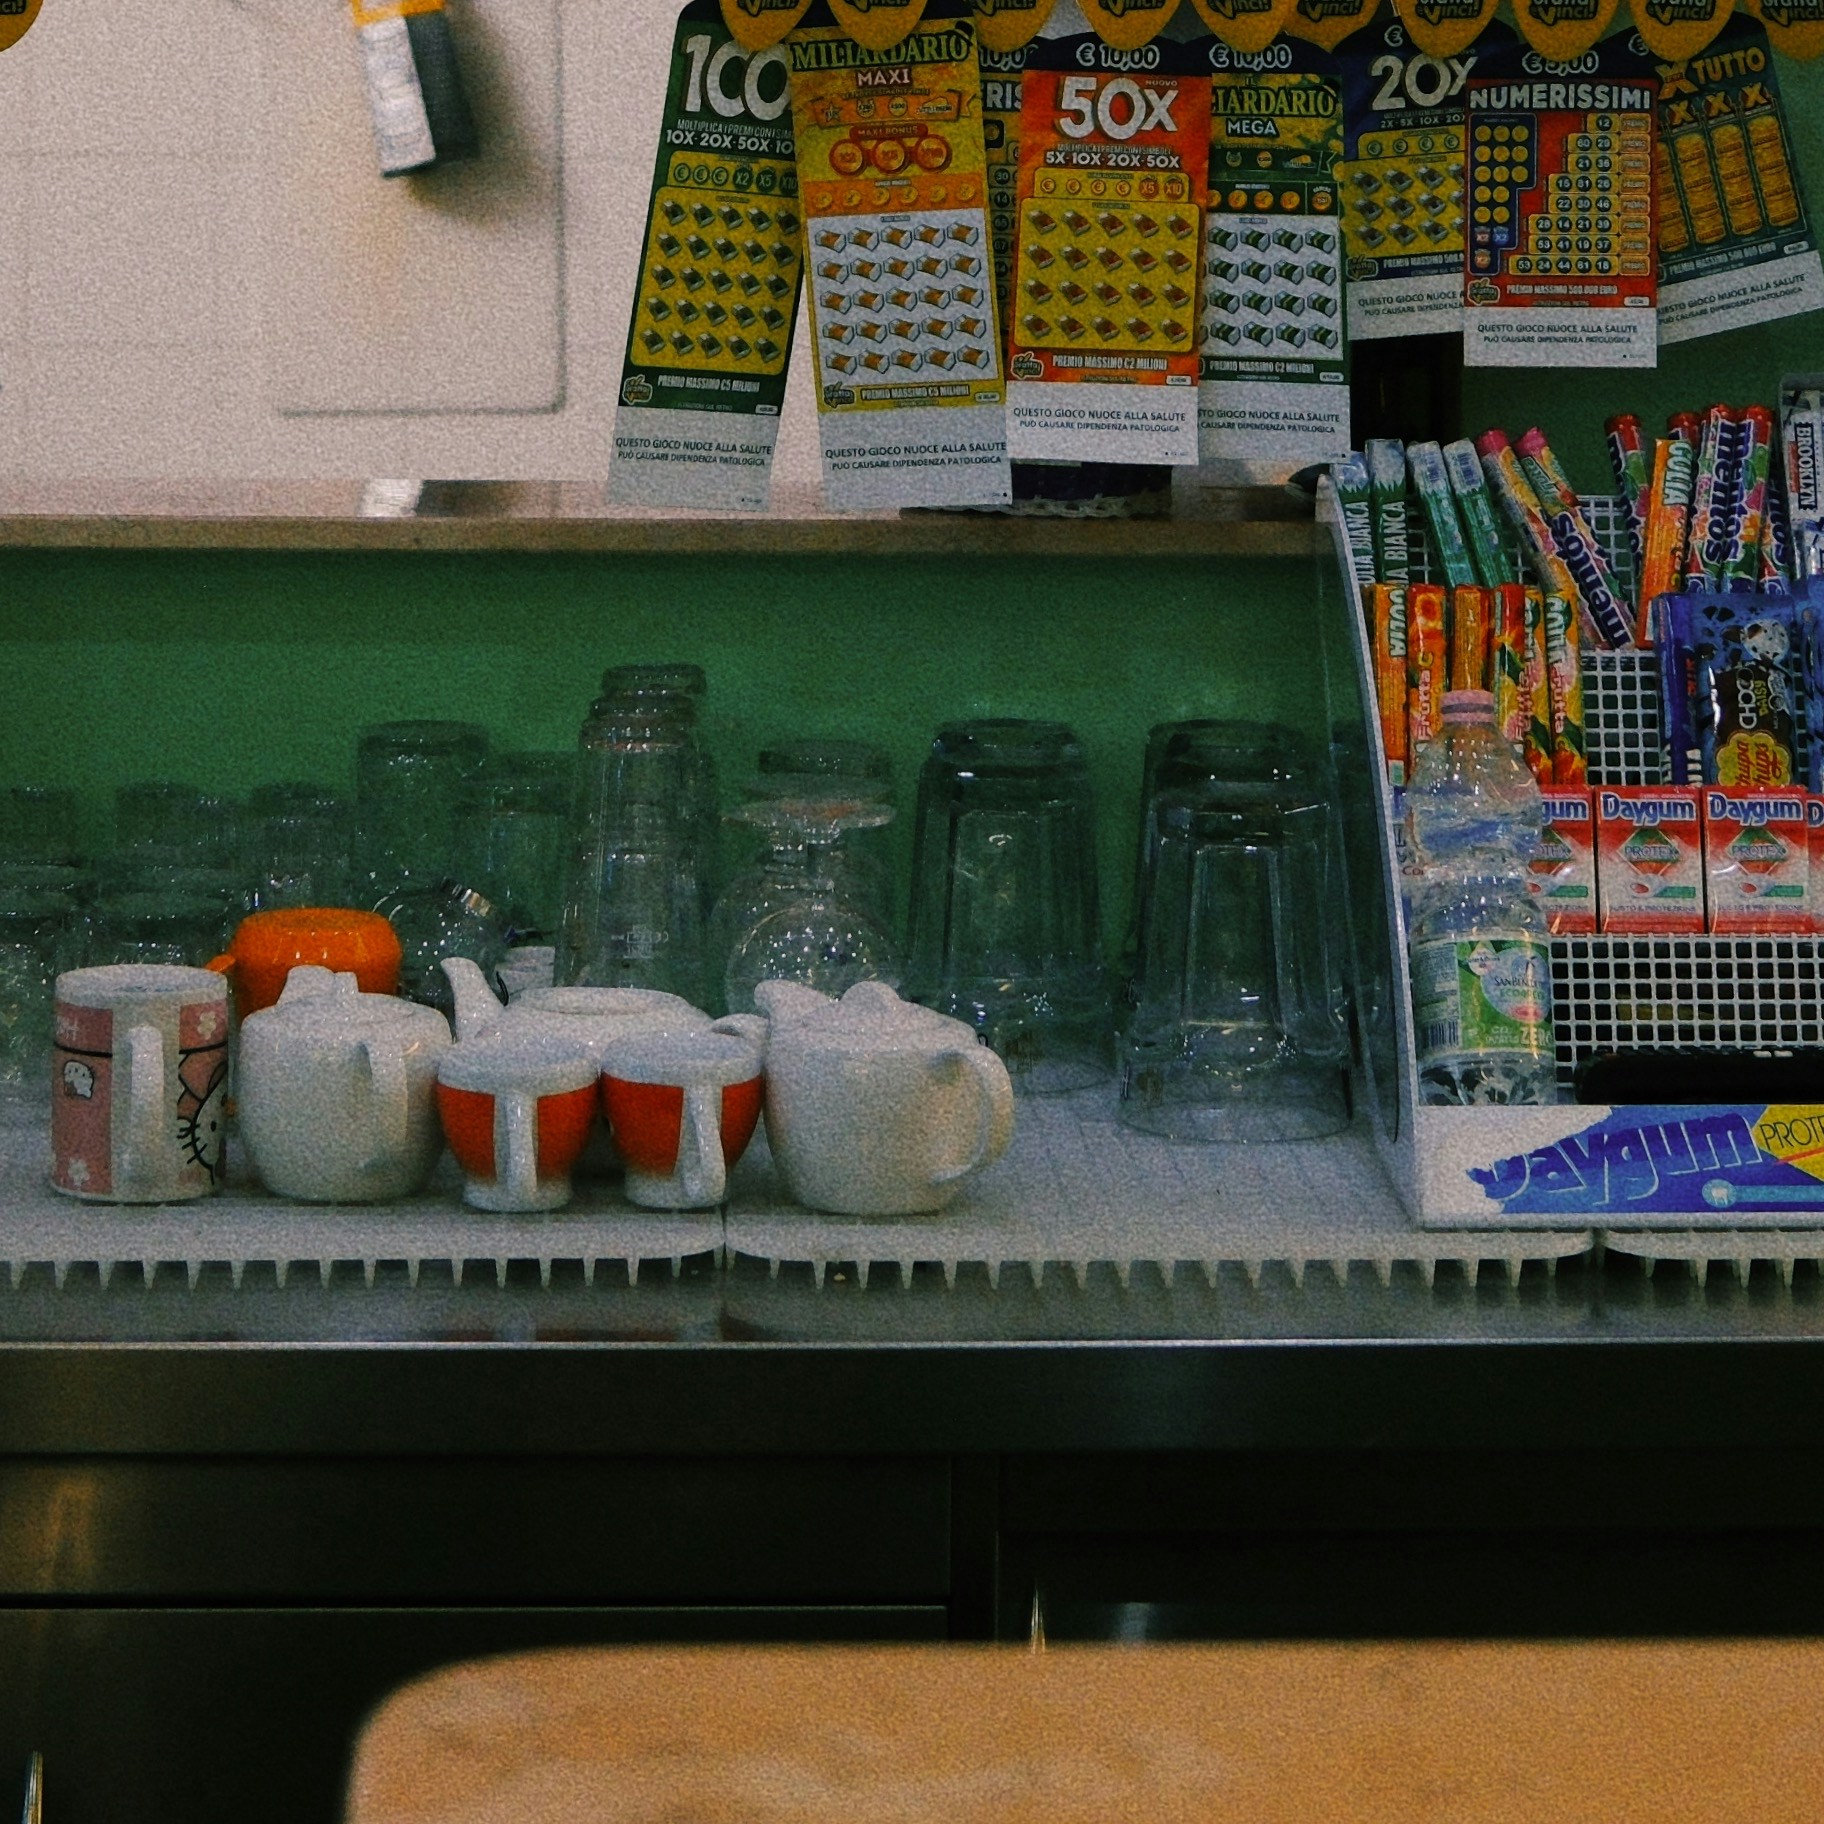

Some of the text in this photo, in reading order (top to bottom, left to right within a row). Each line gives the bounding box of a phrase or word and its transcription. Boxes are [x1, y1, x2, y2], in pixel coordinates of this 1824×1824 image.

[1076, 42, 1096, 67] €
[1208, 43, 1293, 72] € 10,00
[856, 67, 912, 87] MAXI
[1144, 79, 1179, 88] NUOVO
[1058, 75, 1179, 141] 50X
[1470, 82, 1651, 111] NUMERISSIMI
[1227, 119, 1278, 136] MEGA
[1013, 407, 1186, 423] QUESTO GIOCO NUOCE ALLA SALUTE
[1038, 420, 1074, 431] CAUSARE
[1077, 421, 1128, 432] DIPENDENZA
[825, 441, 1007, 459] QUESTO GIOCO NUOCE ALLA SALUTE
[1795, 421, 1819, 513] BROOKLYN
[1702, 422, 1736, 564] mentos
[1383, 499, 1407, 564] BIANCA
[1552, 513, 1635, 649] mentos
[1601, 794, 1696, 833] Daygum
[1709, 794, 1803, 832] Daygum
[1624, 844, 1681, 860] PROTEX
[1730, 843, 1787, 859] PROTEX
